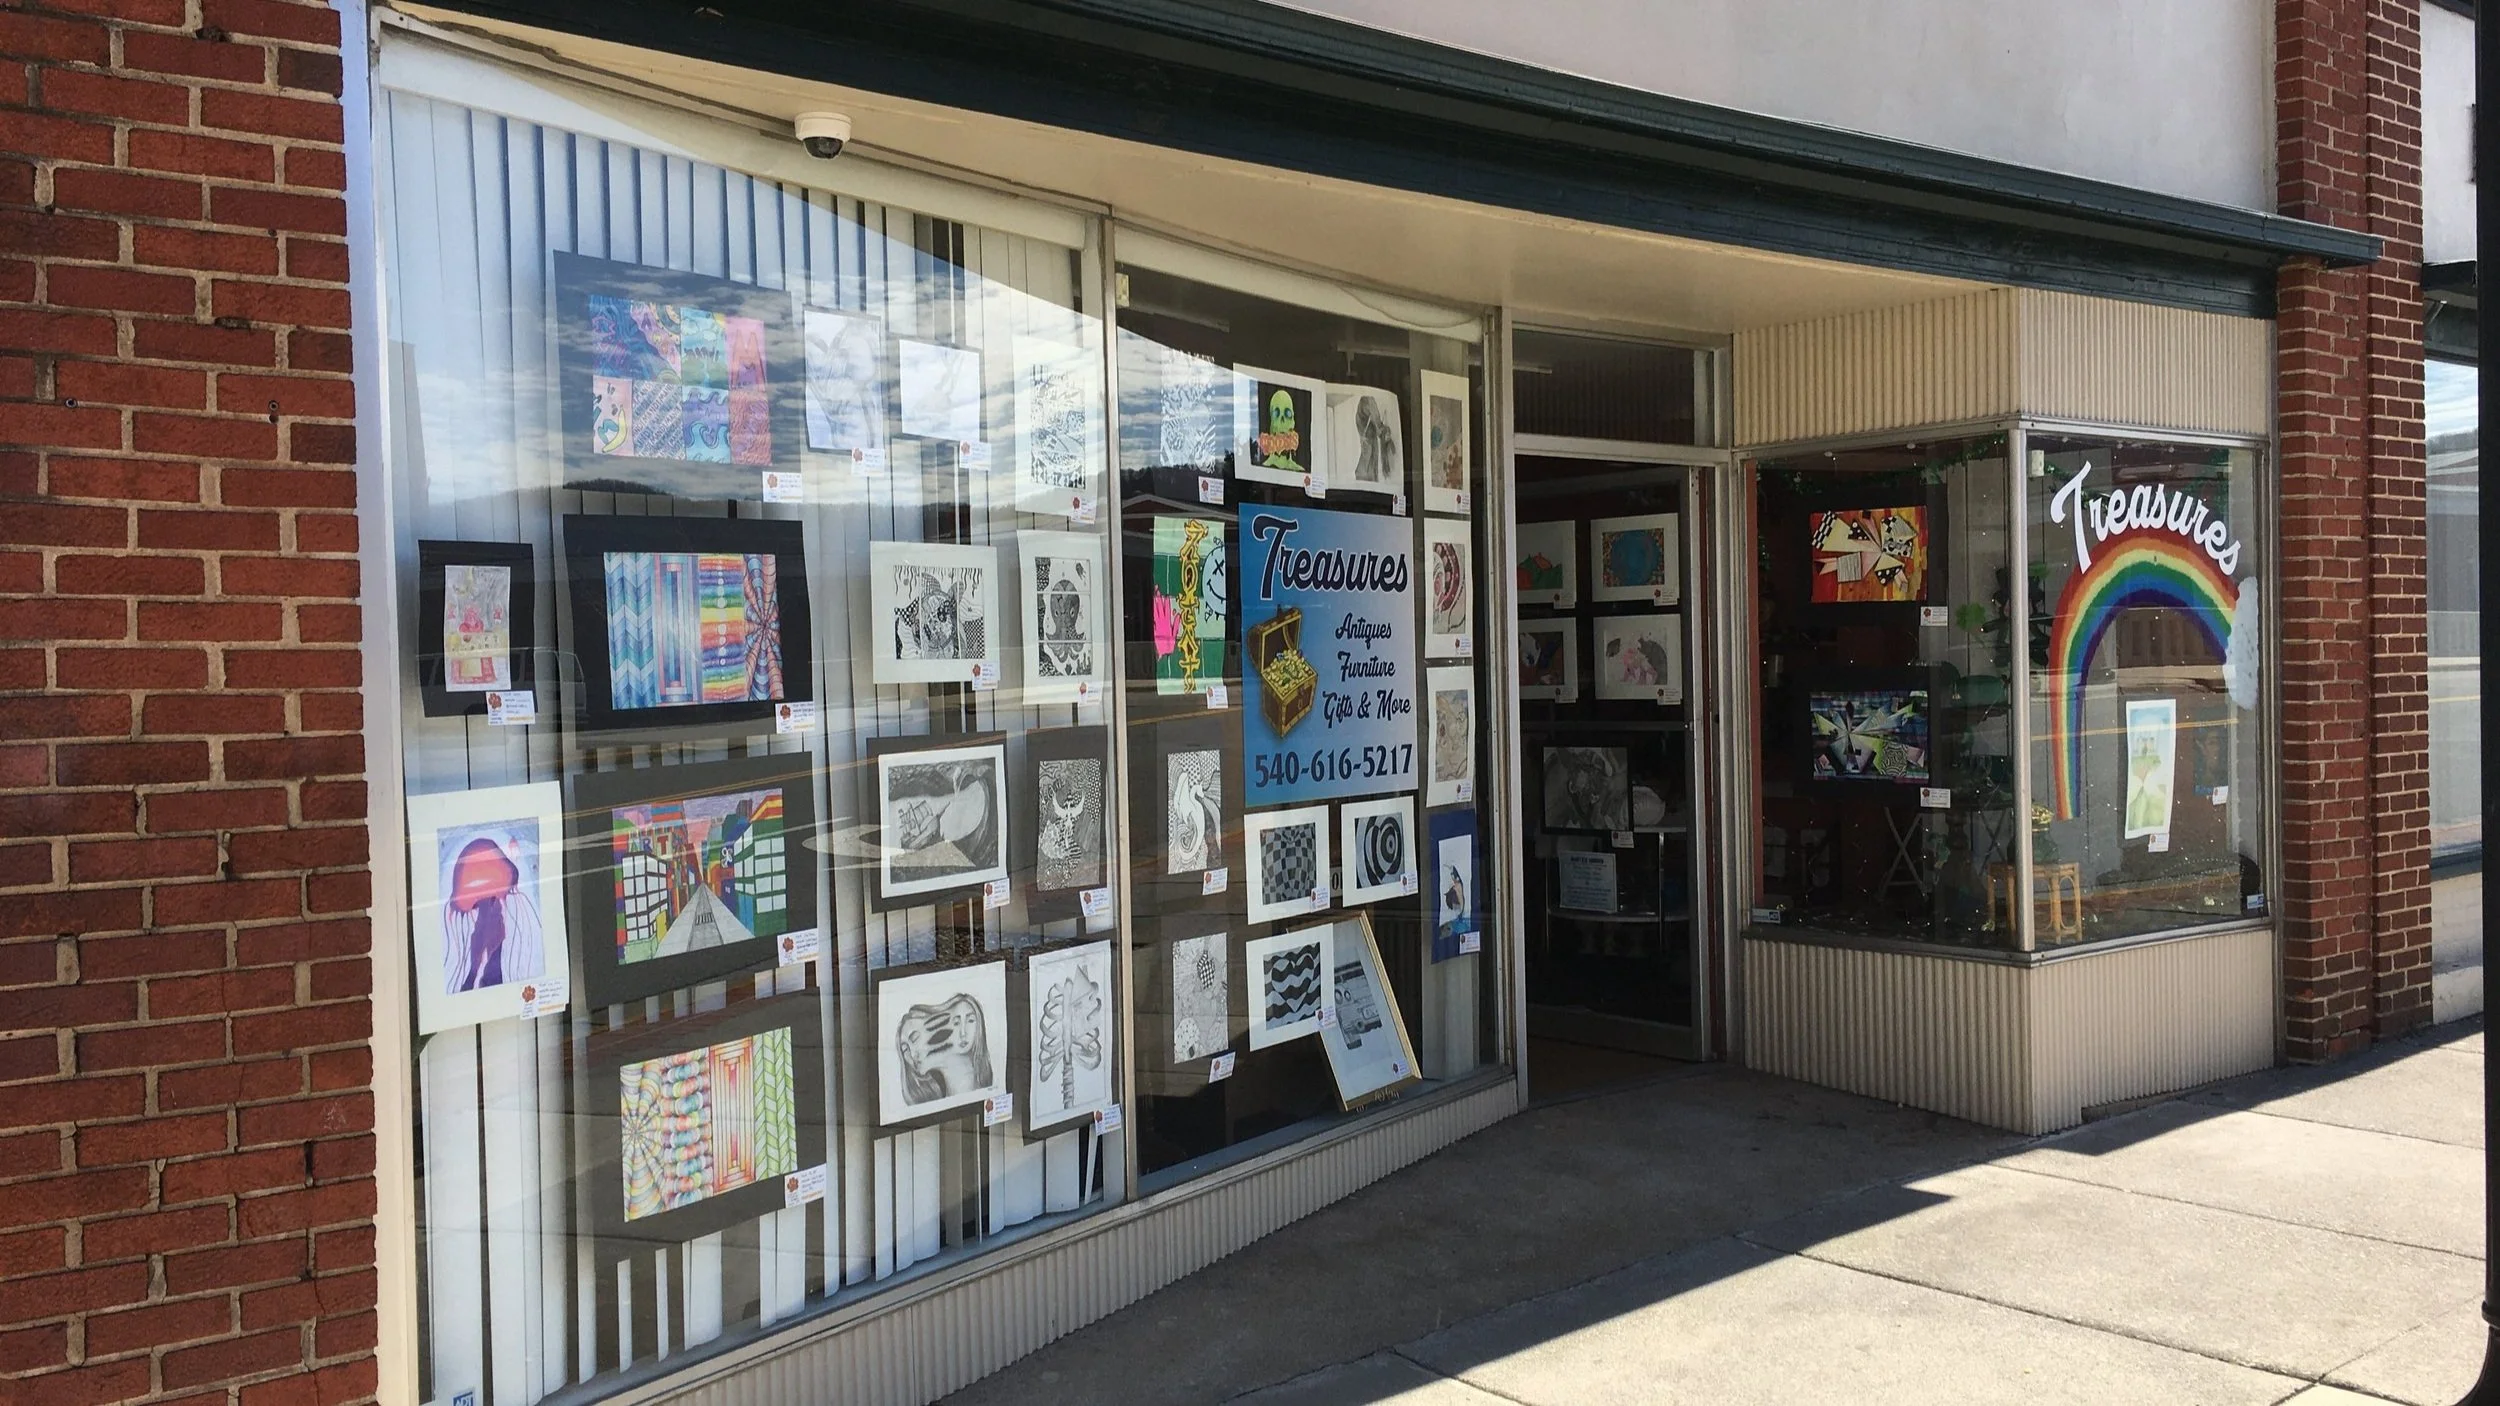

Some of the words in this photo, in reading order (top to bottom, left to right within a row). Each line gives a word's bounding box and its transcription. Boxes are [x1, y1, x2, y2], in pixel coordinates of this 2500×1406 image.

[2050, 460, 2241, 575] Treasures
[1252, 513, 1408, 599] Treasures
[1335, 612, 1392, 649] Antiques
[1337, 650, 1396, 684] Furniture
[1322, 691, 1354, 729] Gifts
[1357, 694, 1371, 719] &
[1376, 689, 1411, 722] More
[1255, 743, 1413, 788] 540-616-5217
